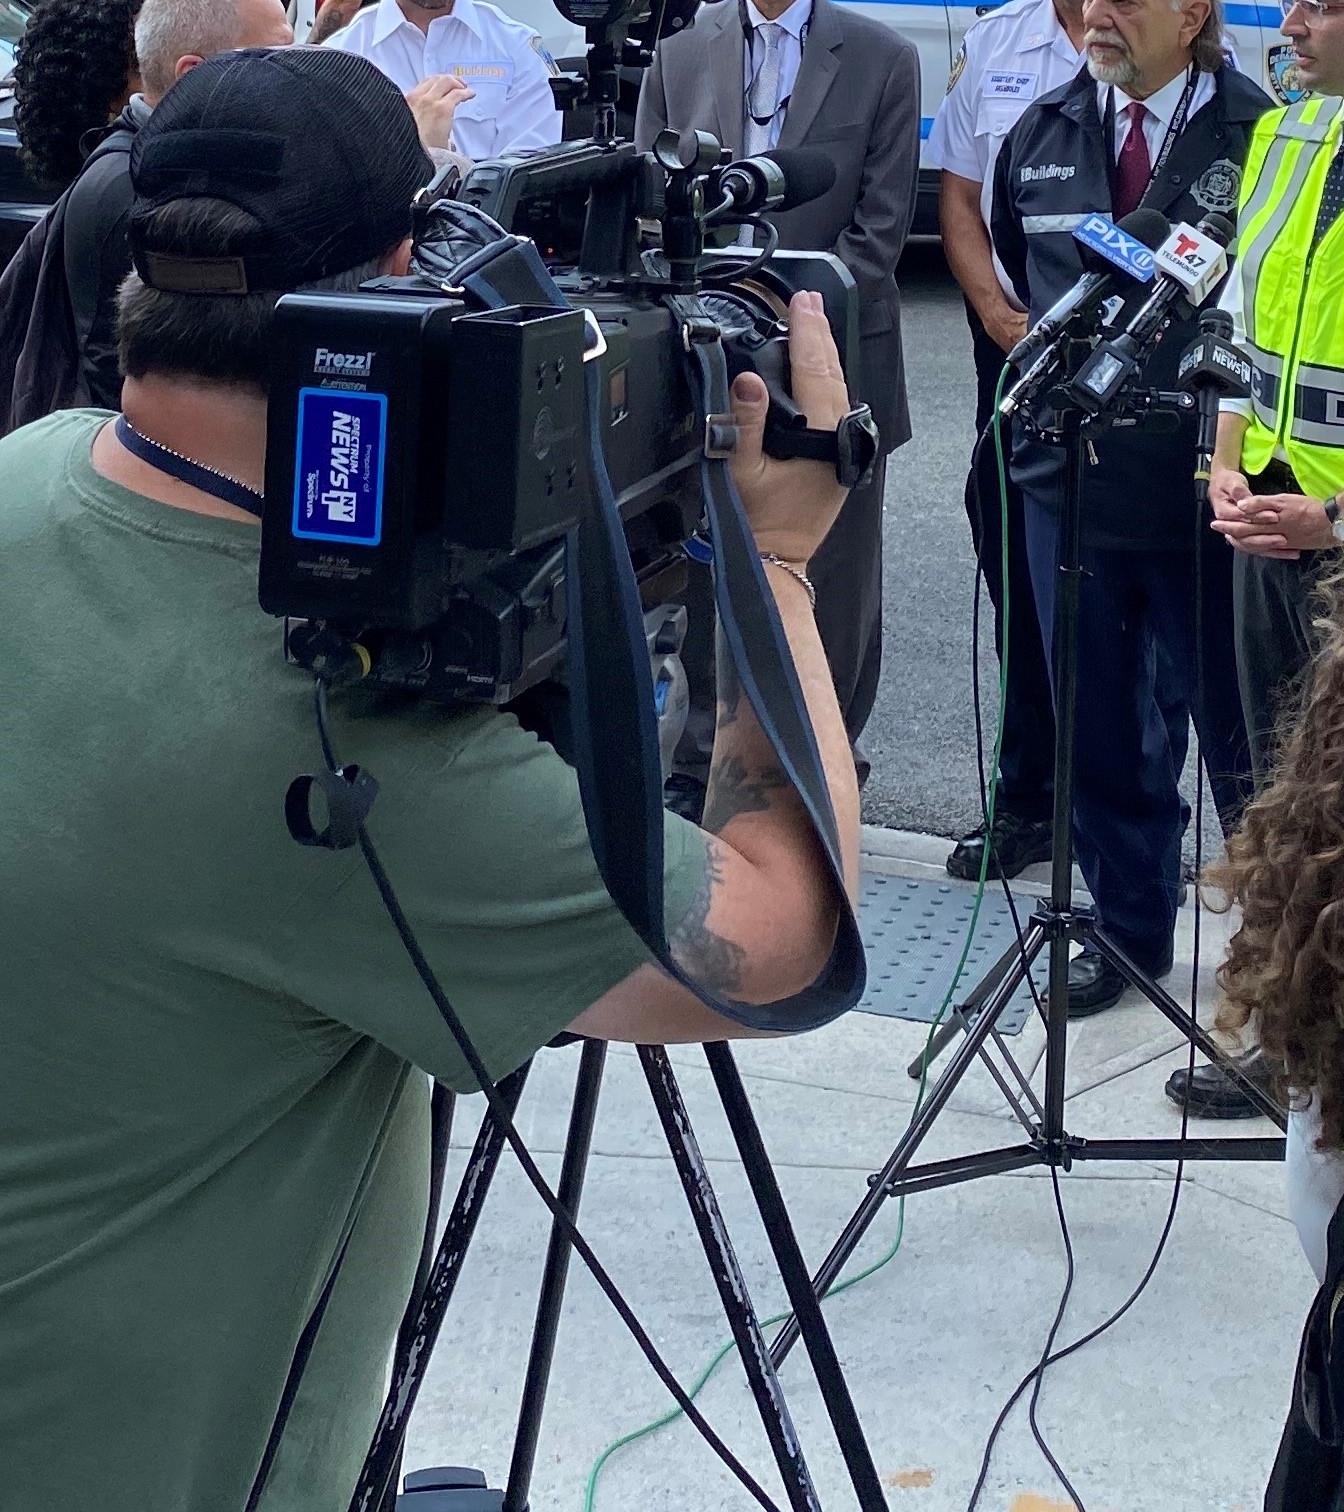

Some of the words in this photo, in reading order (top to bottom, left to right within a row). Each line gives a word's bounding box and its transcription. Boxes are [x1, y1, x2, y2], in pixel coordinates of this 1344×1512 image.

[1025, 163, 1075, 182] Buildings
[1084, 217, 1138, 257] PIX
[1162, 250, 1199, 278] TELEMUNDO
[1185, 253, 1206, 268] 47
[1212, 350, 1241, 374] NEWS
[330, 411, 351, 489] NEWS
[350, 417, 361, 474] SPECTRUM
[363, 444, 372, 482] Property
[307, 473, 316, 518] Spectrum
[363, 484, 371, 492] of
[343, 496, 354, 519] NY
